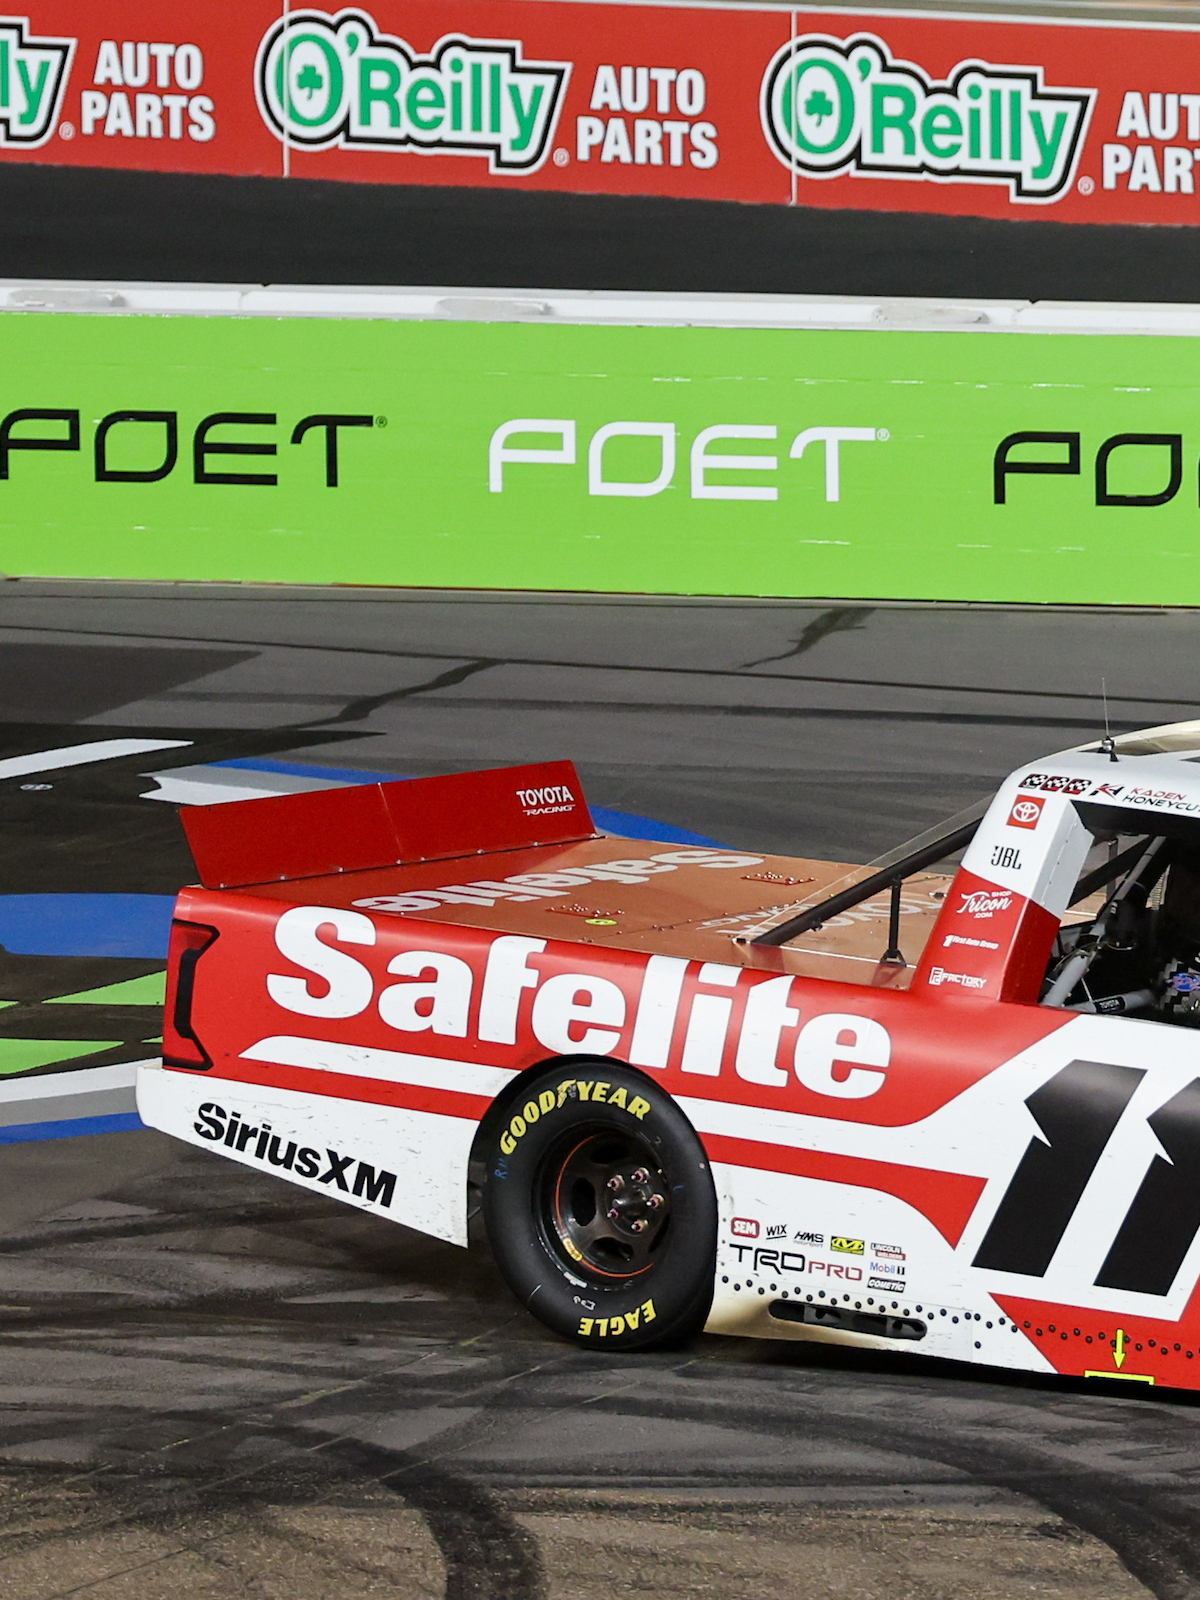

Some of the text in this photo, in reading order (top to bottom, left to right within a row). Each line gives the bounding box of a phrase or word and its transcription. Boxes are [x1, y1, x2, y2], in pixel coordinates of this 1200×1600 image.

[93, 40, 204, 90] AUTO
[276, 31, 545, 152] O'Reilly
[590, 64, 706, 117] AUTO
[81, 90, 216, 142] PARTS
[782, 55, 1069, 181] O'Reilly
[576, 116, 719, 170] PARTS
[0, 408, 375, 488] POET
[488, 418, 876, 502] POET
[516, 786, 574, 807] TOYOTA
[523, 804, 576, 816] RACING
[1132, 787, 1187, 801] KADEN
[990, 845, 1022, 870] JBL
[351, 850, 766, 912] Safelite
[956, 891, 1013, 914] Tricon
[266, 907, 892, 1099] Safelite
[194, 1102, 398, 1208] SiriusXM
[733, 1220, 757, 1236] SEM
[766, 1224, 788, 1236] WIX
[794, 1231, 825, 1243] HMS
[729, 1243, 863, 1281] TRD PRO
[870, 1261, 896, 1274] Mobil
[868, 1278, 905, 1292] COMETIC
[577, 1298, 657, 1337] EAGLE
